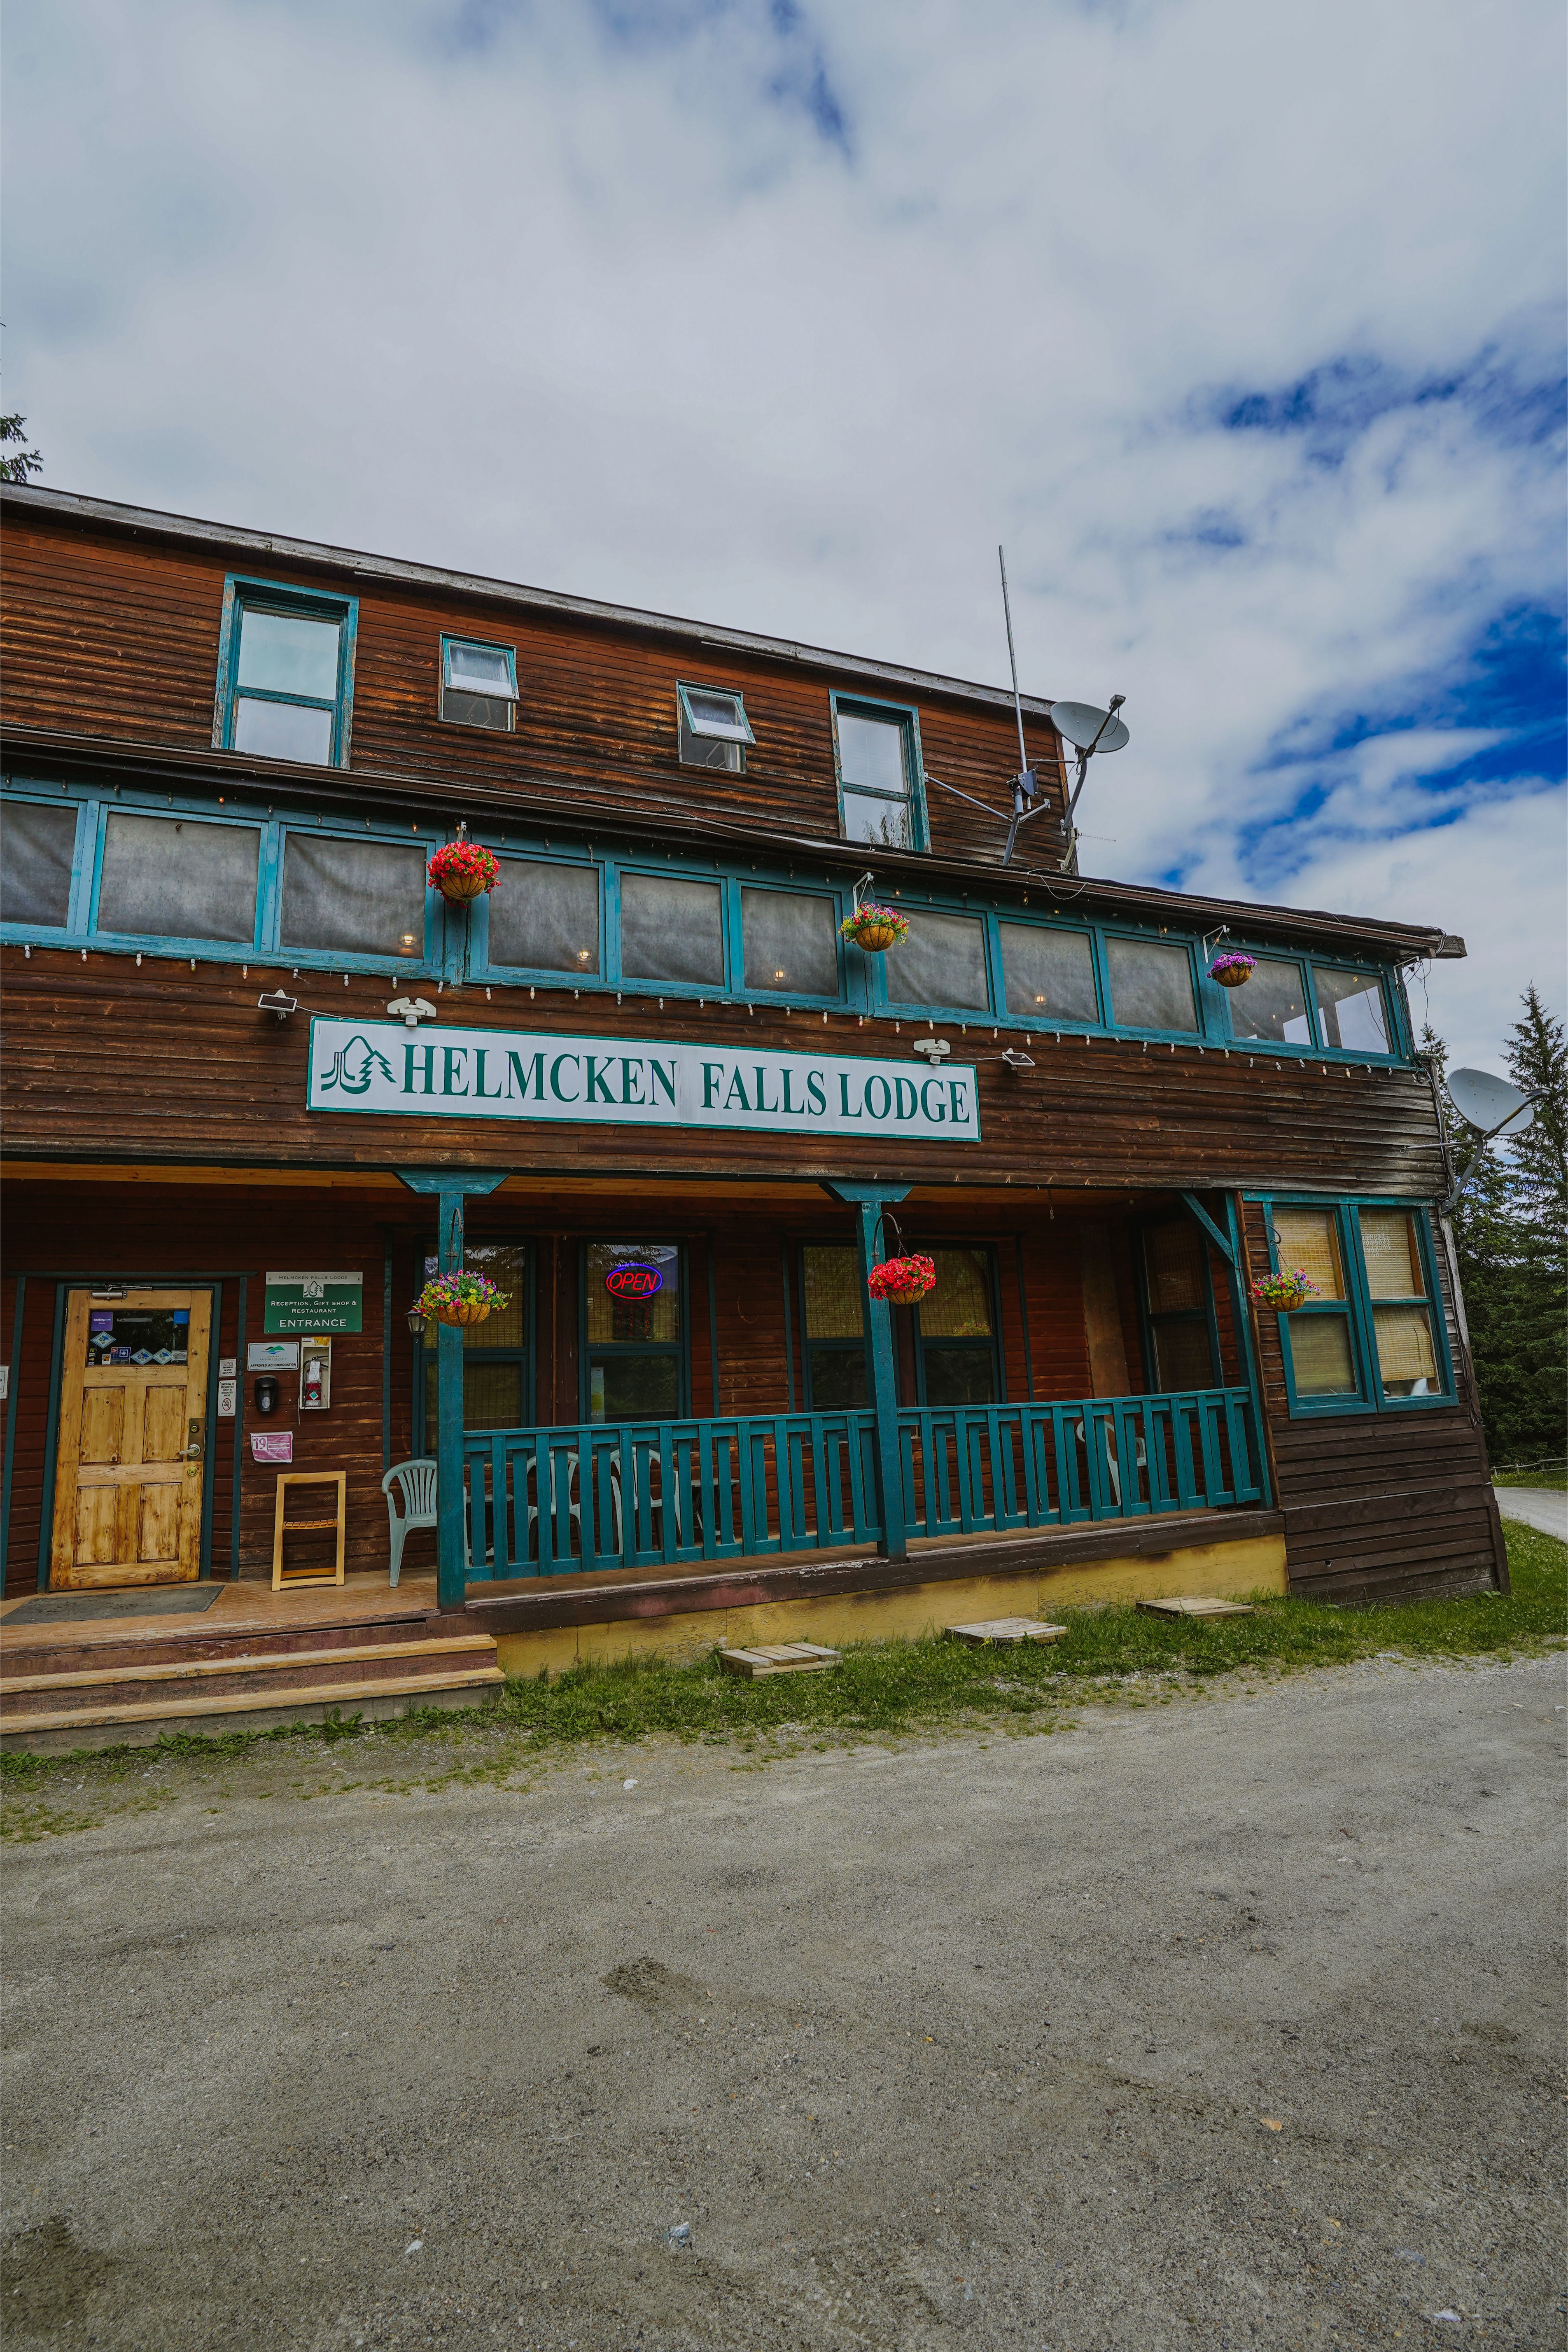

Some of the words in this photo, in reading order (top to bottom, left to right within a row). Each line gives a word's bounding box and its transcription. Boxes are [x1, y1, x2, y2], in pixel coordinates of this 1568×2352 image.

[399, 1043, 678, 1107] HELMCKEN
[700, 1062, 827, 1116] FALLS
[837, 1073, 970, 1123] LODGE
[609, 1273, 658, 1290] OPEN
[253, 1438, 266, 1449] 19
